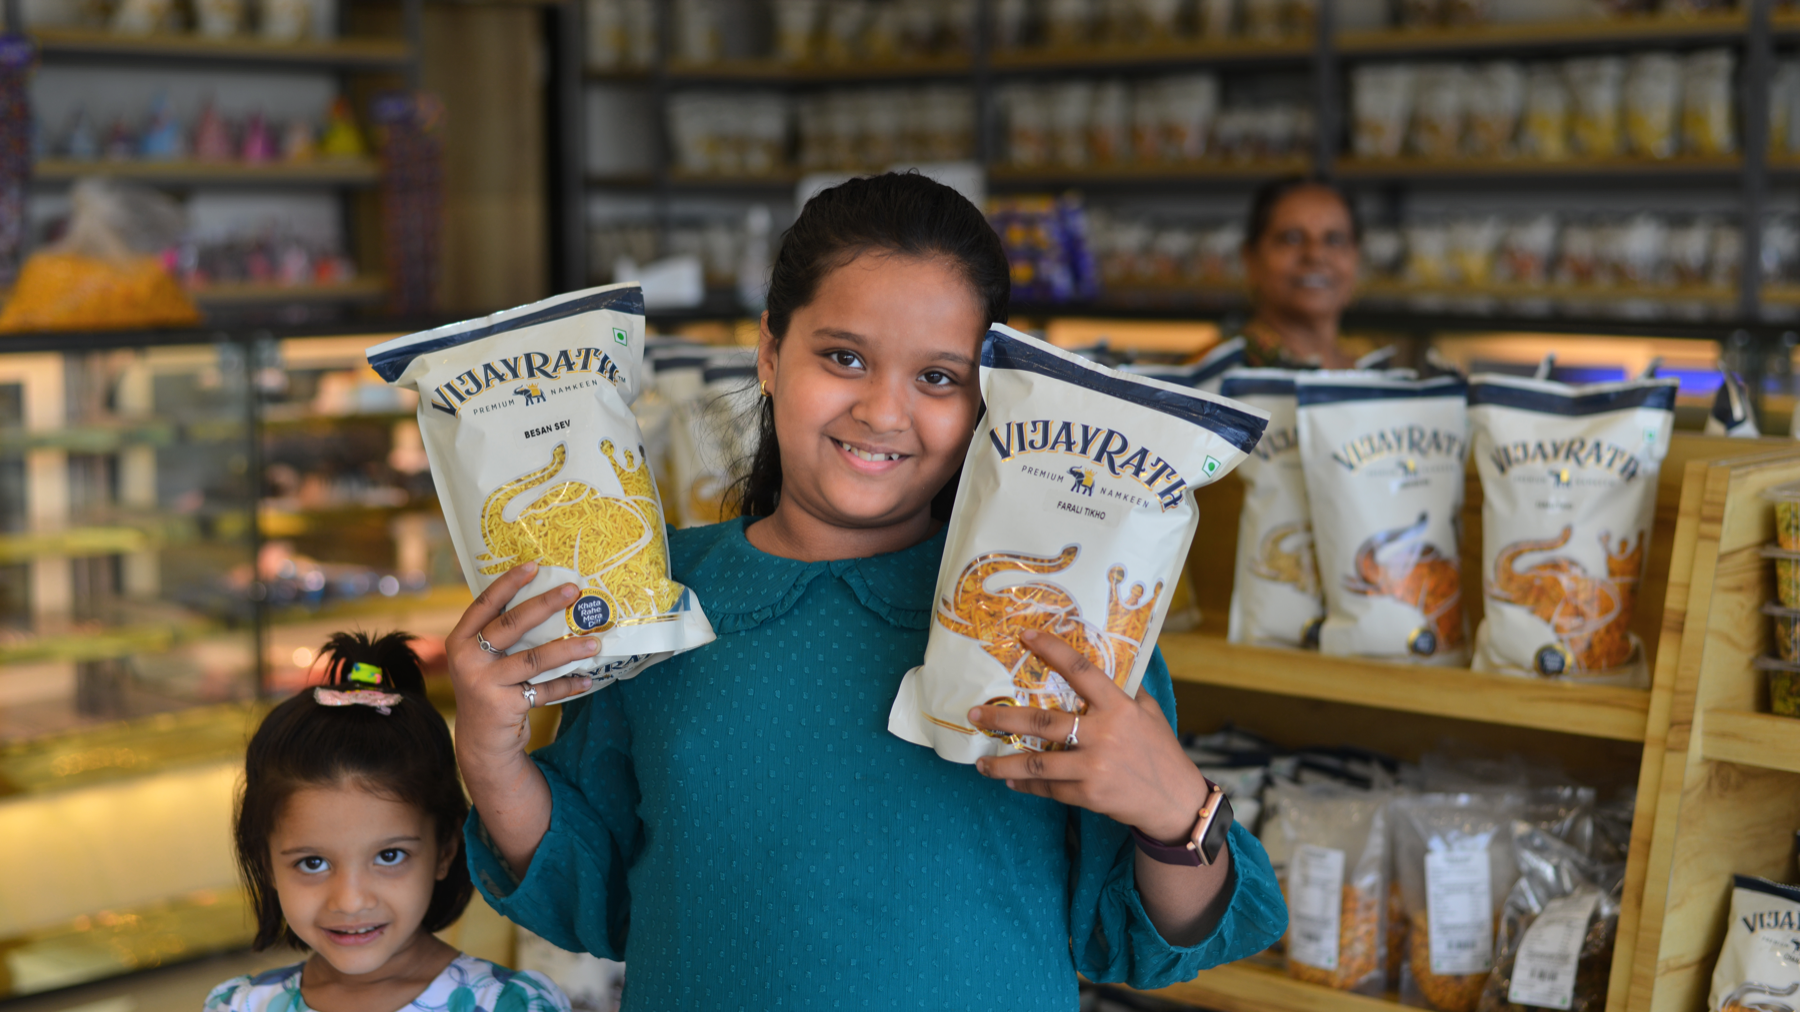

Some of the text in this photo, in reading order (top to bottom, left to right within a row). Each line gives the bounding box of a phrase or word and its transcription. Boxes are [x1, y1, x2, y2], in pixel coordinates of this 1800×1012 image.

[431, 347, 619, 419] VIJAYRATH
[473, 379, 598, 415] PREMIUM NAMKEEN
[524, 418, 571, 439] BESAN SEV
[988, 419, 1188, 513] VIJAYRATH
[1021, 464, 1150, 509] PREMIUM NAMKEEN
[1056, 500, 1107, 521] FARALI TIKHO
[577, 600, 602, 612] Khata
[580, 606, 602, 617] Rahe
[582, 613, 603, 624] Mera
[1741, 909, 1800, 934] VIJA
